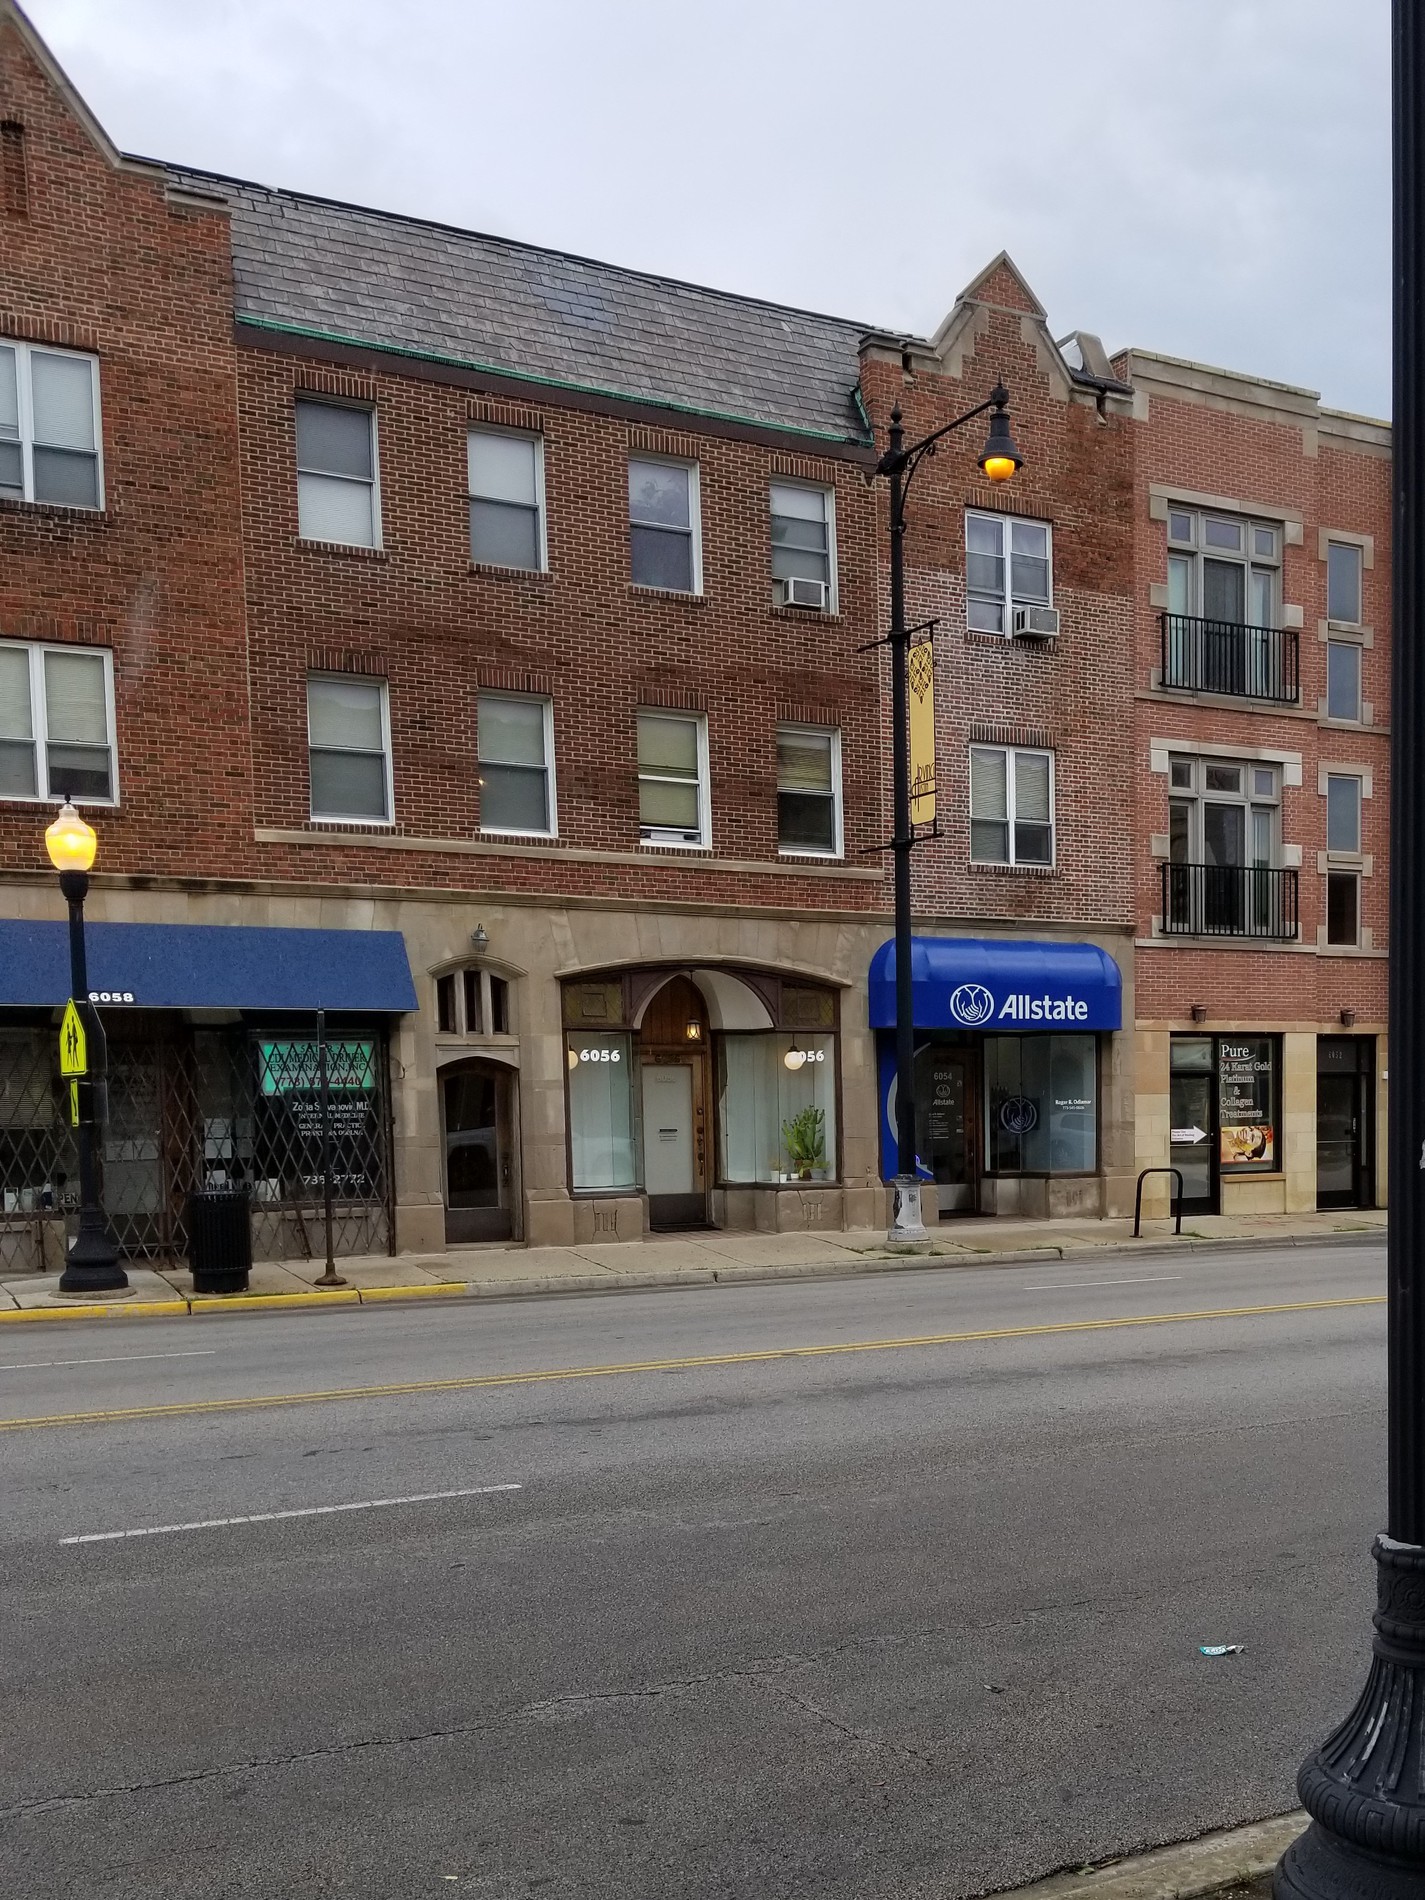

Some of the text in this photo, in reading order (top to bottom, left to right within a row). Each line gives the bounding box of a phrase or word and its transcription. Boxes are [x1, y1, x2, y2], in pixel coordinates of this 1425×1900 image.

[88, 992, 134, 1002] 6058
[998, 994, 1088, 1020] Allstate
[580, 1049, 620, 1062] 6056
[1221, 1044, 1250, 1057] Pure
[289, 1052, 332, 1062] MEDICL
[794, 1050, 825, 1062] 056
[270, 1063, 348, 1072] EXAMINAION,
[1220, 1062, 1272, 1071] 24 Karat Gold
[934, 1072, 952, 1080] 6054
[1220, 1074, 1255, 1083] Platinum
[1233, 1086, 1241, 1095] &
[1220, 1097, 1254, 1108] Collagen
[1220, 1110, 1262, 1119] Treatments
